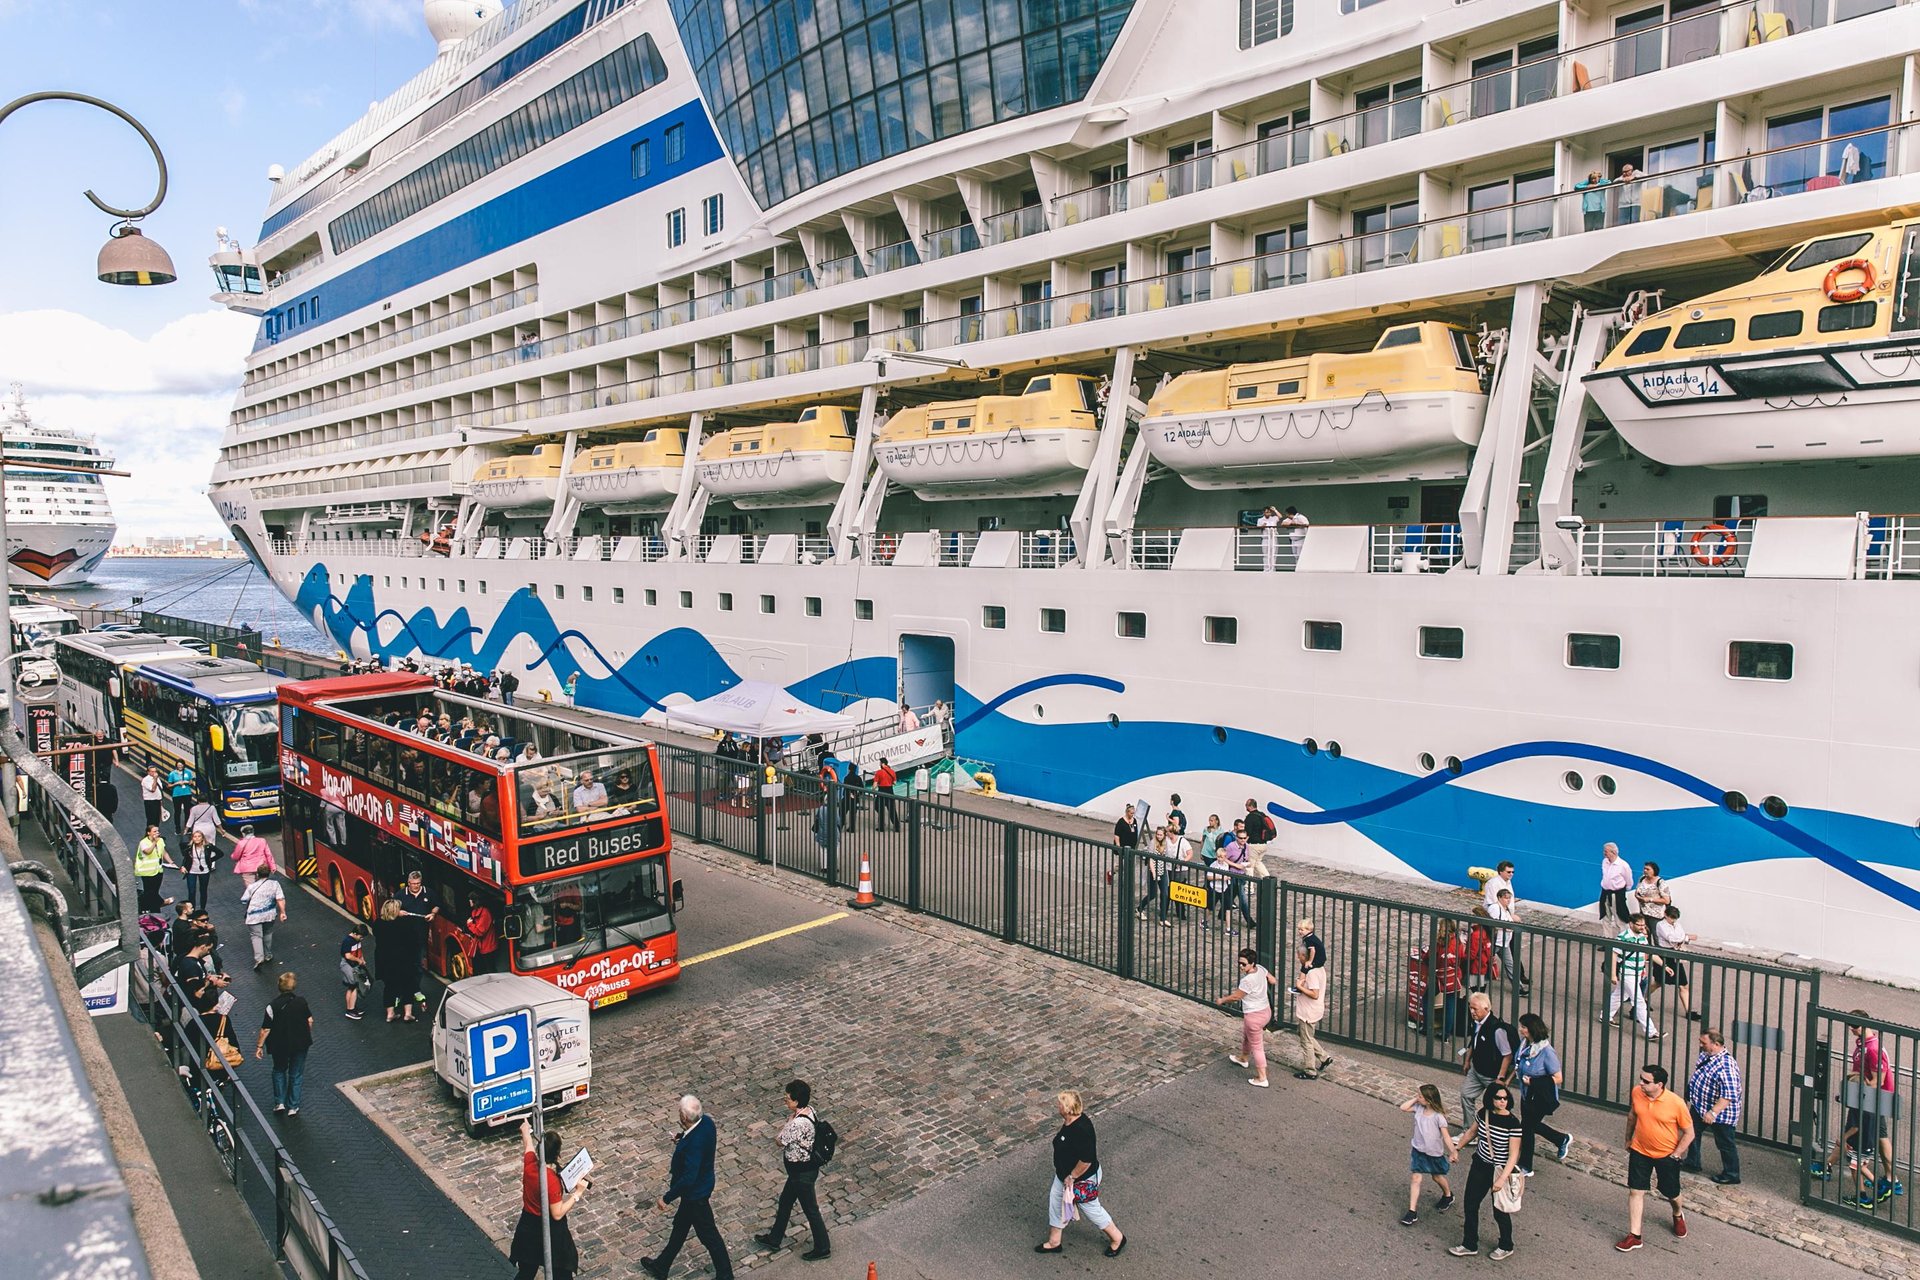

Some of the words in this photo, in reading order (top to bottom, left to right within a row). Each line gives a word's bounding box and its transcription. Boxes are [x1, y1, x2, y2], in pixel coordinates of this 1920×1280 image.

[1697, 380, 1719, 396] 14
[1164, 431, 1176, 442] 12
[886, 455, 894, 464] 10
[713, 693, 757, 709] URLAUB
[28, 708, 56, 718] -70%
[321, 765, 353, 798] HOP-ON
[347, 792, 383, 826] HOP-OFF
[544, 840, 580, 868] Red
[1174, 893, 1202, 905] område
[1177, 885, 1200, 897] Privat
[556, 956, 611, 988] HOP-ON
[601, 950, 656, 980] HOP-OFF
[605, 978, 631, 992] BUSES
[91, 997, 111, 1006] FREE
[545, 1024, 581, 1041] OUTLET
[482, 1025, 518, 1077] P
[480, 1097, 490, 1110] P
